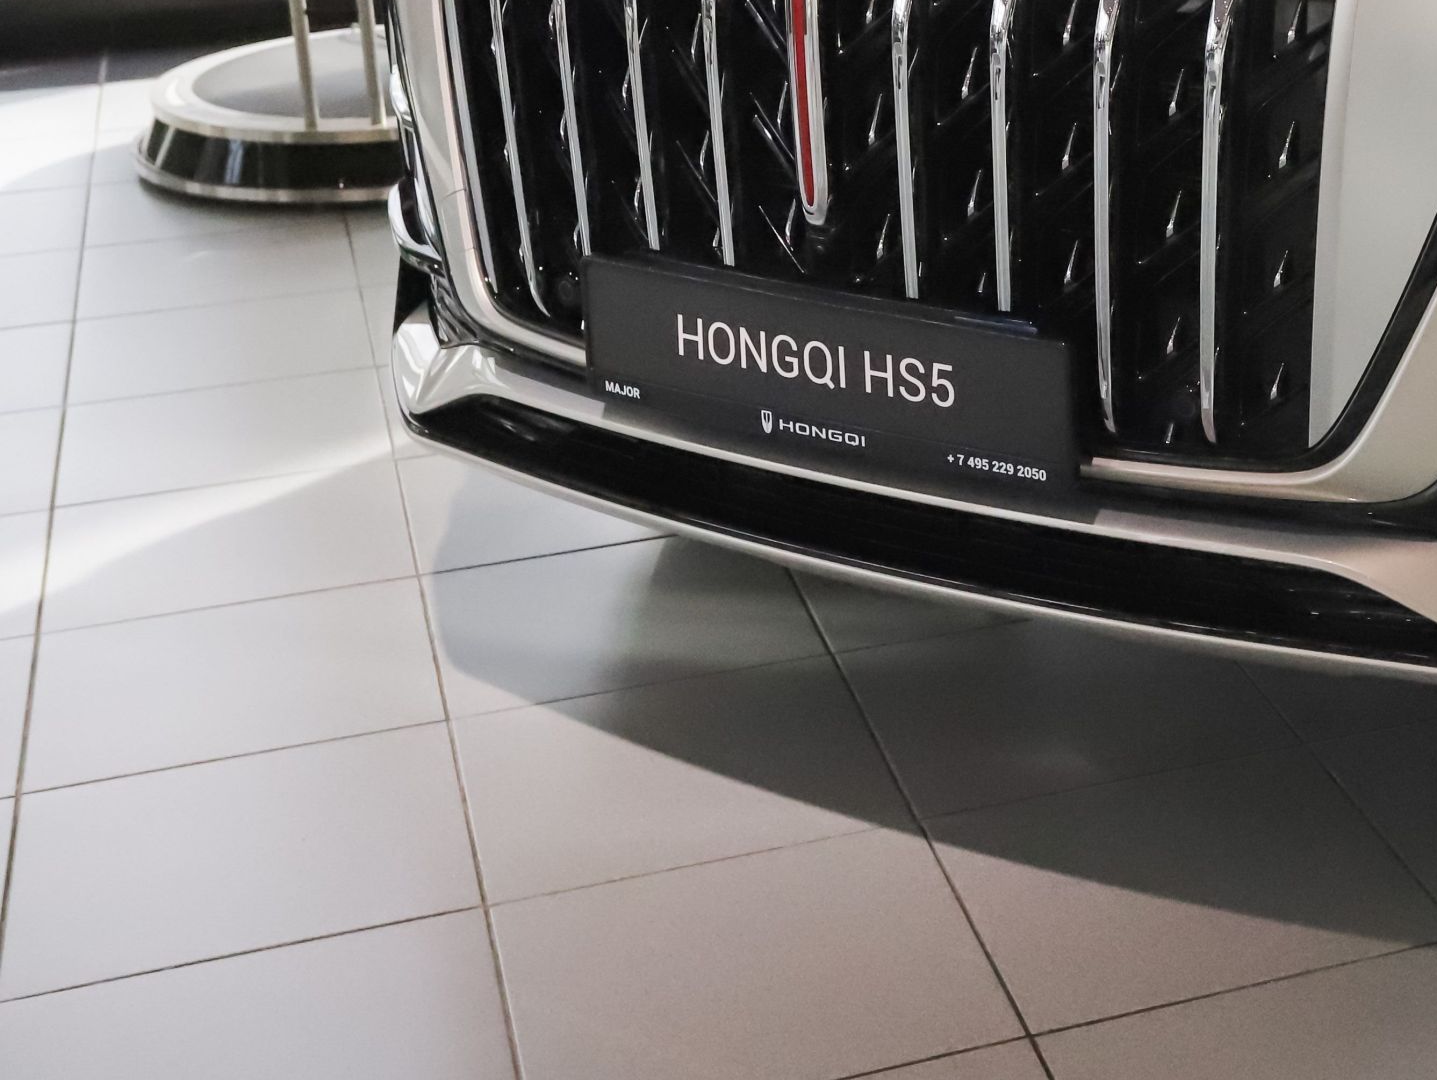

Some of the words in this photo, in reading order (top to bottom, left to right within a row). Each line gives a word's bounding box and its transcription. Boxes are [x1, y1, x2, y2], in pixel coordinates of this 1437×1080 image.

[677, 314, 846, 390] HONGQI
[863, 350, 955, 408] HS5
[605, 380, 641, 399] MAJOR
[778, 419, 866, 448] HONGQI
[956, 454, 965, 466] 7
[967, 456, 990, 471] 495
[991, 460, 1014, 475] 229
[1016, 465, 1047, 481] 2050
